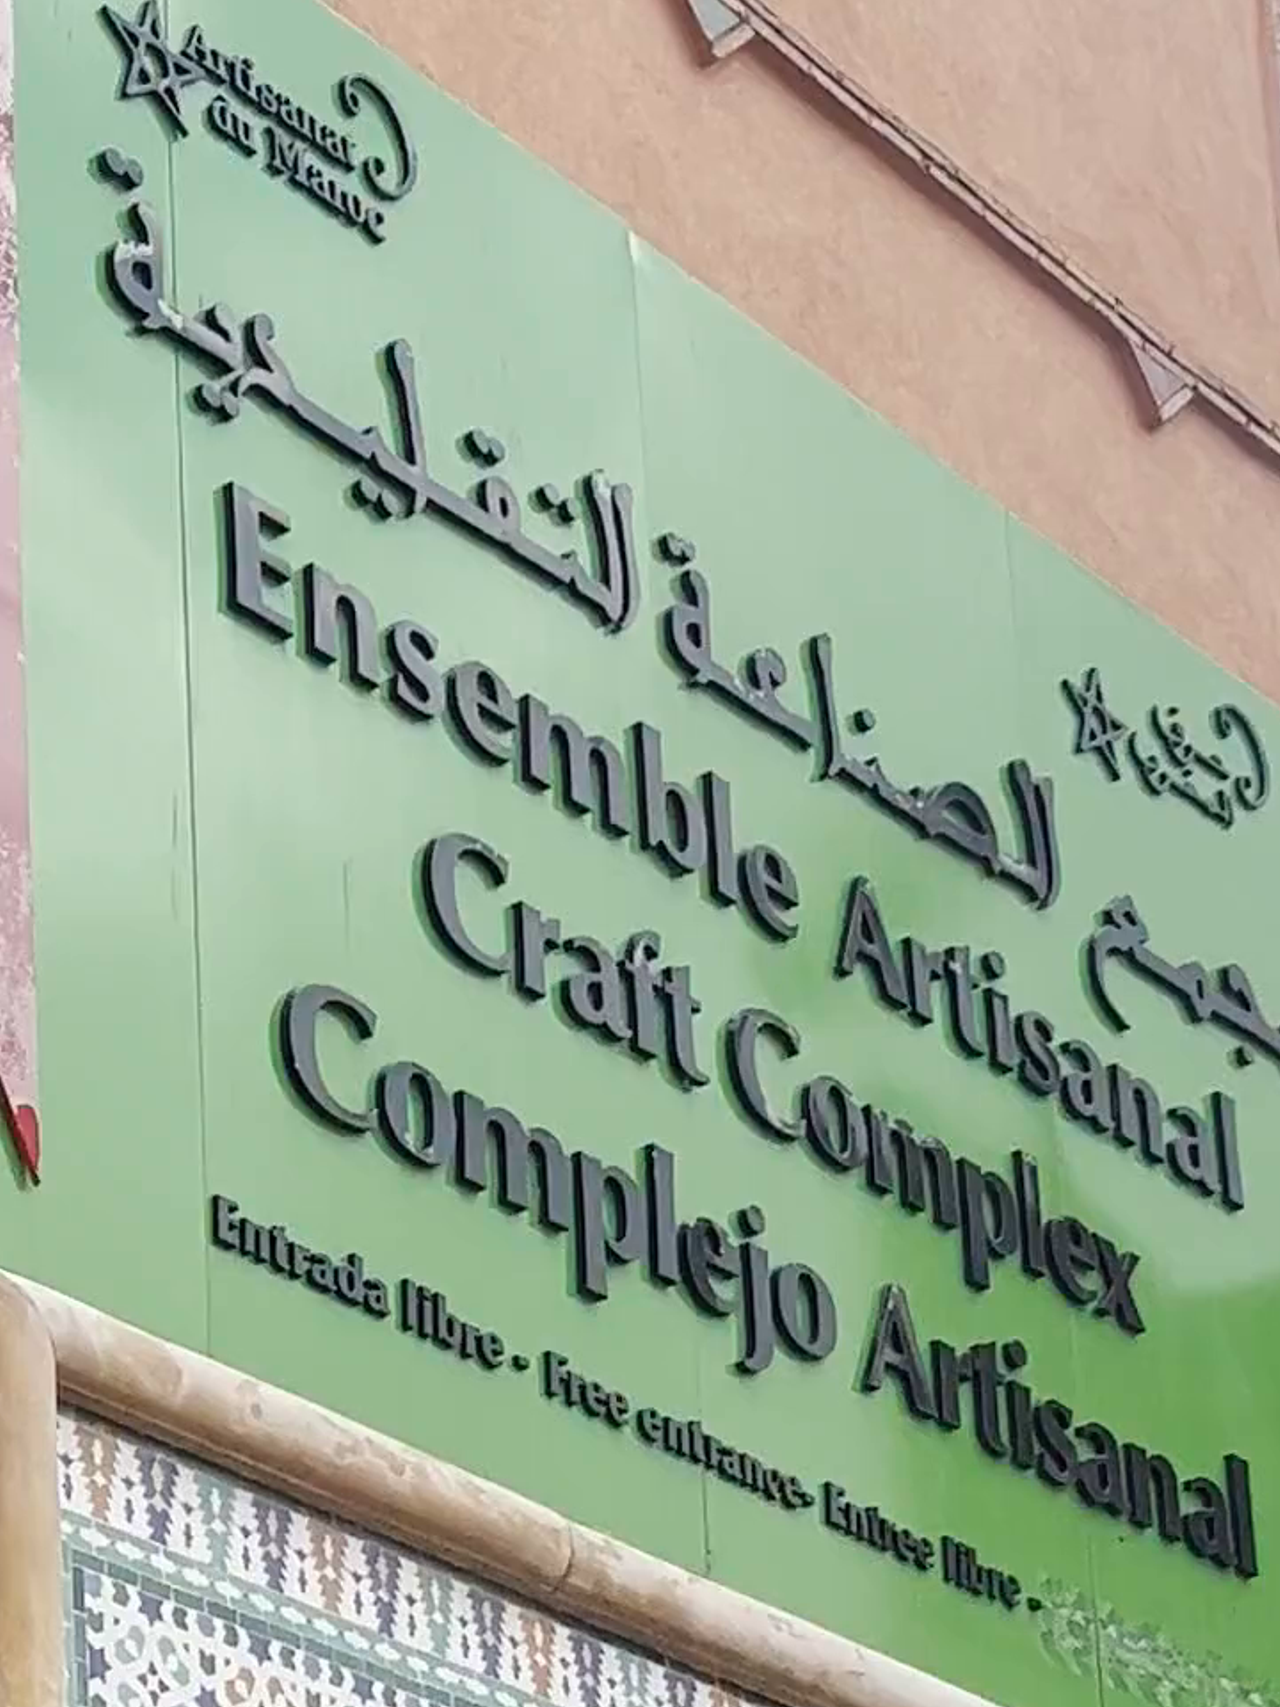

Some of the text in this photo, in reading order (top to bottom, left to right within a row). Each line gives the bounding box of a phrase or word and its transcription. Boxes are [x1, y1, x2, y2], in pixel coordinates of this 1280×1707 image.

[88, 146, 639, 634] التقليدية
[214, 480, 1245, 1212] Ensemble Artisanal
[652, 531, 1062, 911] الصناعة
[271, 984, 1258, 1581] Complejo Artisanal
[412, 832, 1148, 1336] Craft Complex
[210, 1193, 390, 1319] Entrada
[398, 1277, 505, 1370] libre
[539, 1349, 629, 1429] Free
[939, 1534, 1022, 1612] libre
